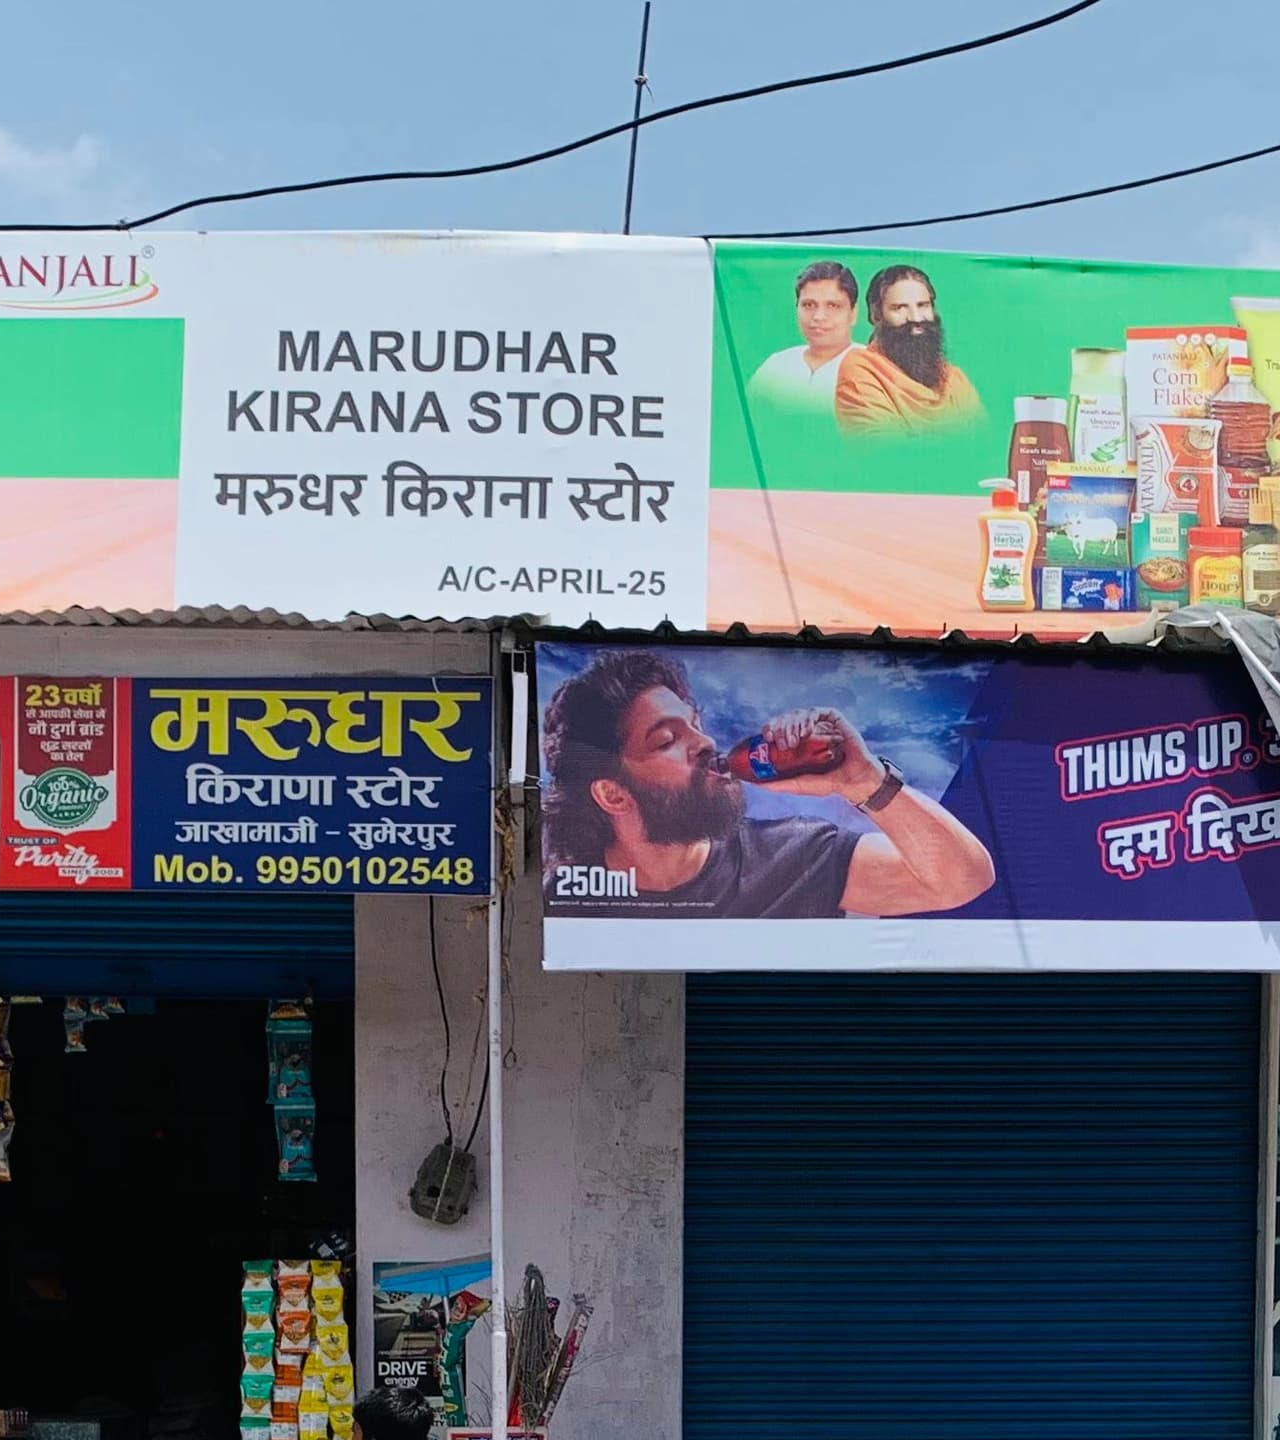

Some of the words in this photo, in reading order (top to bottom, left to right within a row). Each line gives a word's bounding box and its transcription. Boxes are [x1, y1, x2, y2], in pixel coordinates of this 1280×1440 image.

[277, 328, 619, 376] MARUDHAR
[1153, 369, 1198, 386] Corn
[226, 390, 452, 434] KIRANA
[469, 391, 665, 439] STORE
[215, 471, 369, 518] मरुधर
[383, 460, 553, 521] किराना
[568, 462, 674, 525] स्टोर
[993, 535, 1025, 545] Herbal
[437, 565, 667, 598] A/C-APRIL-25
[24, 684, 61, 707] 23
[150, 688, 481, 762] मरुधर
[1063, 731, 1186, 793] THUMS
[1197, 721, 1242, 770] UP
[21, 783, 106, 813] Organic
[185, 763, 337, 808] किराणा
[346, 767, 444, 809] स्टोर
[7, 837, 40, 845] TRUST
[42, 837, 58, 845] OF
[175, 815, 320, 844] जाखामाजी
[348, 817, 457, 851] सुमेरपुर
[1104, 819, 1172, 873] दम
[13, 843, 100, 885] Purity
[153, 854, 244, 884] Mob.
[256, 857, 475, 886] 9950102548
[556, 865, 639, 898] 250ml
[377, 1360, 429, 1377] DRIVE
[383, 1376, 421, 1388] energy
